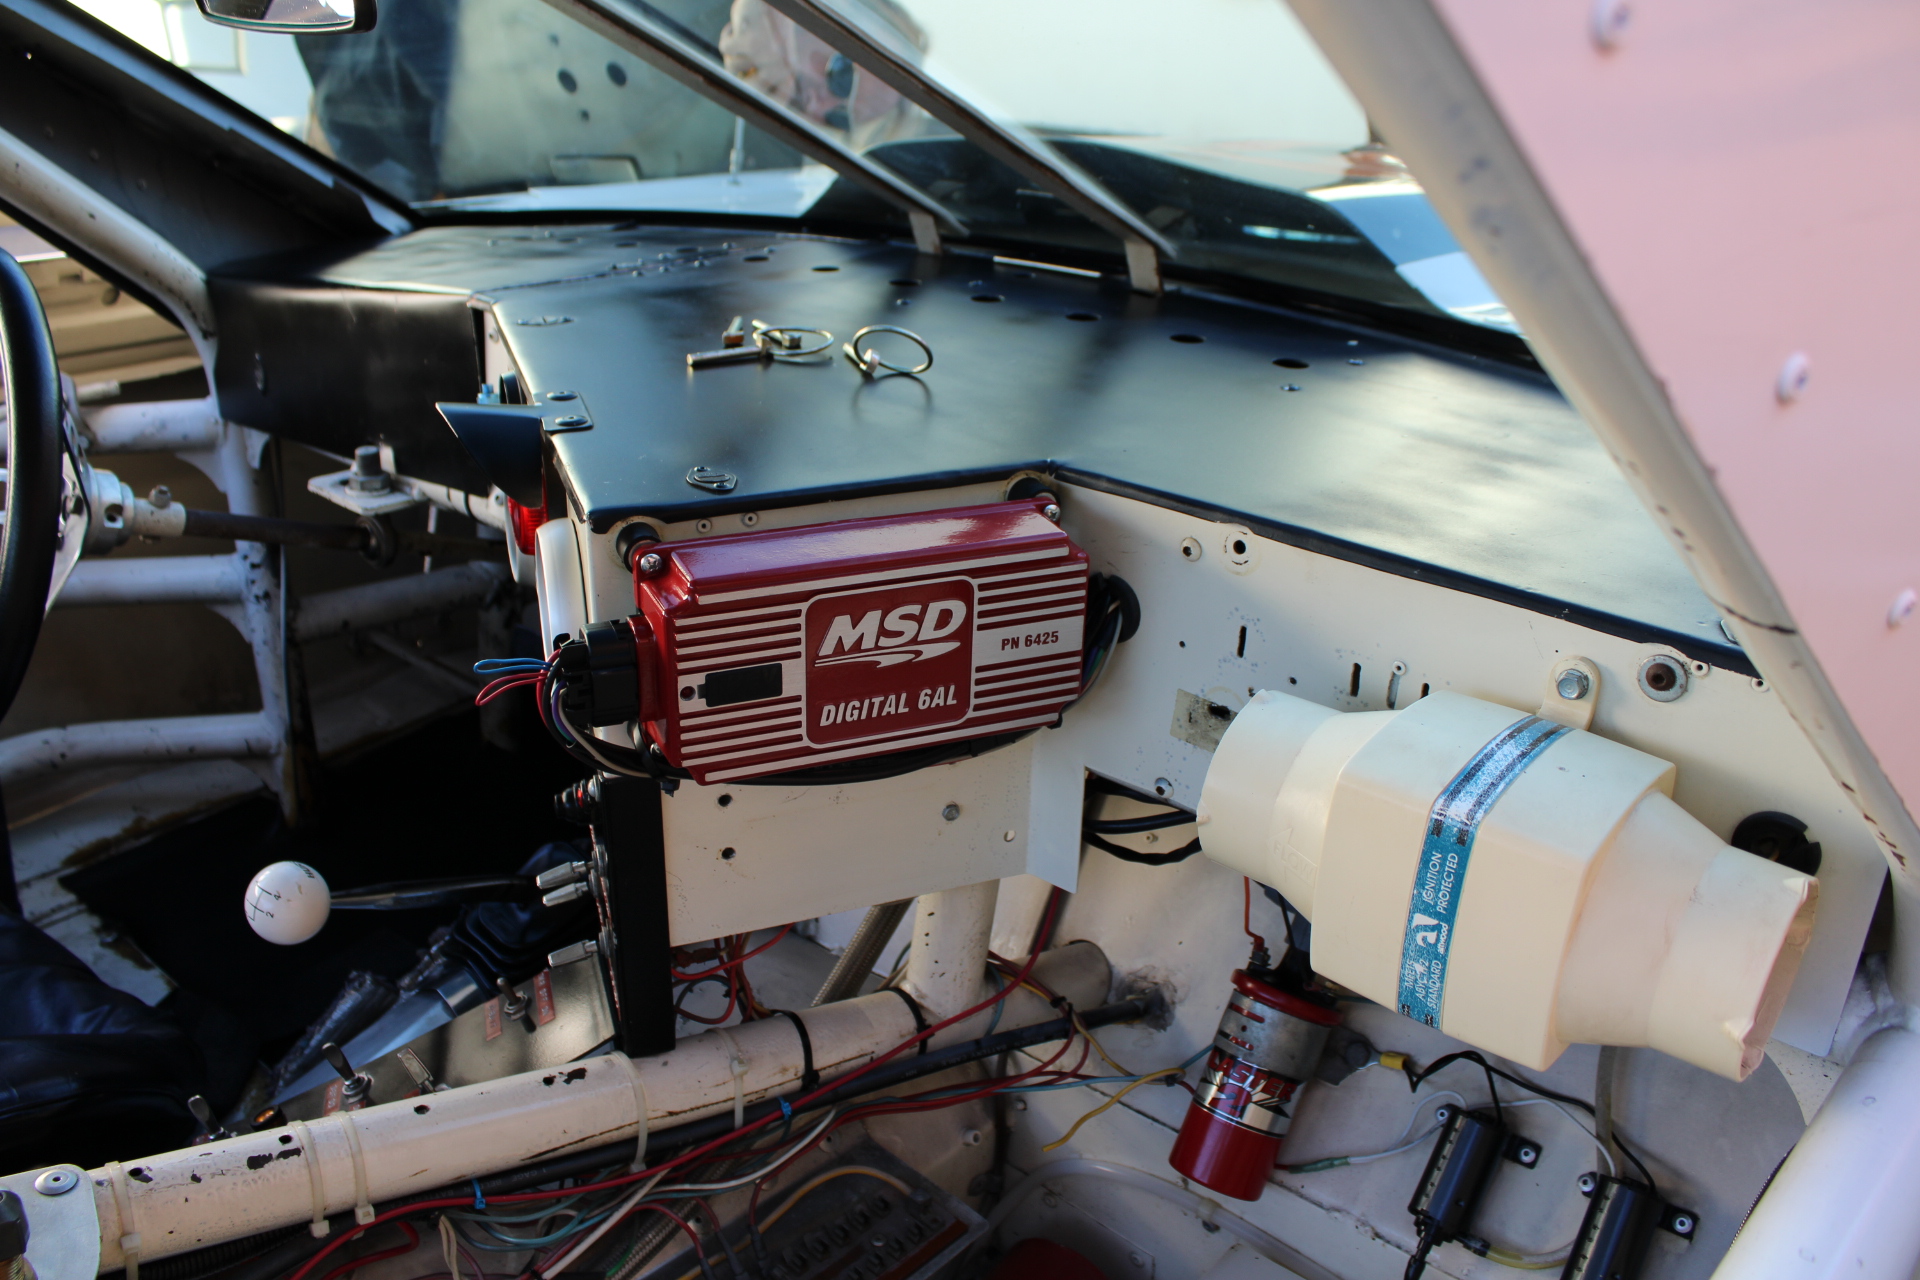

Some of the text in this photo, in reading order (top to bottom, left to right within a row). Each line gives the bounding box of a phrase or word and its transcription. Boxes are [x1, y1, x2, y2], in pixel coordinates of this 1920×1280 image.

[818, 599, 967, 657] MSD
[1001, 630, 1060, 651] PN 6425
[819, 684, 958, 727] DIGITAL 6AL
[1423, 851, 1443, 905] IGNITION
[1436, 852, 1459, 914] PROTECTED
[1404, 958, 1416, 989] MEETS
[1414, 973, 1429, 1002] ABYC
[1426, 960, 1443, 1010] STANDARD
[1207, 1082, 1253, 1119] 2
[462, 1177, 502, 1194] BELDN
[510, 1168, 538, 1183] GAGE
